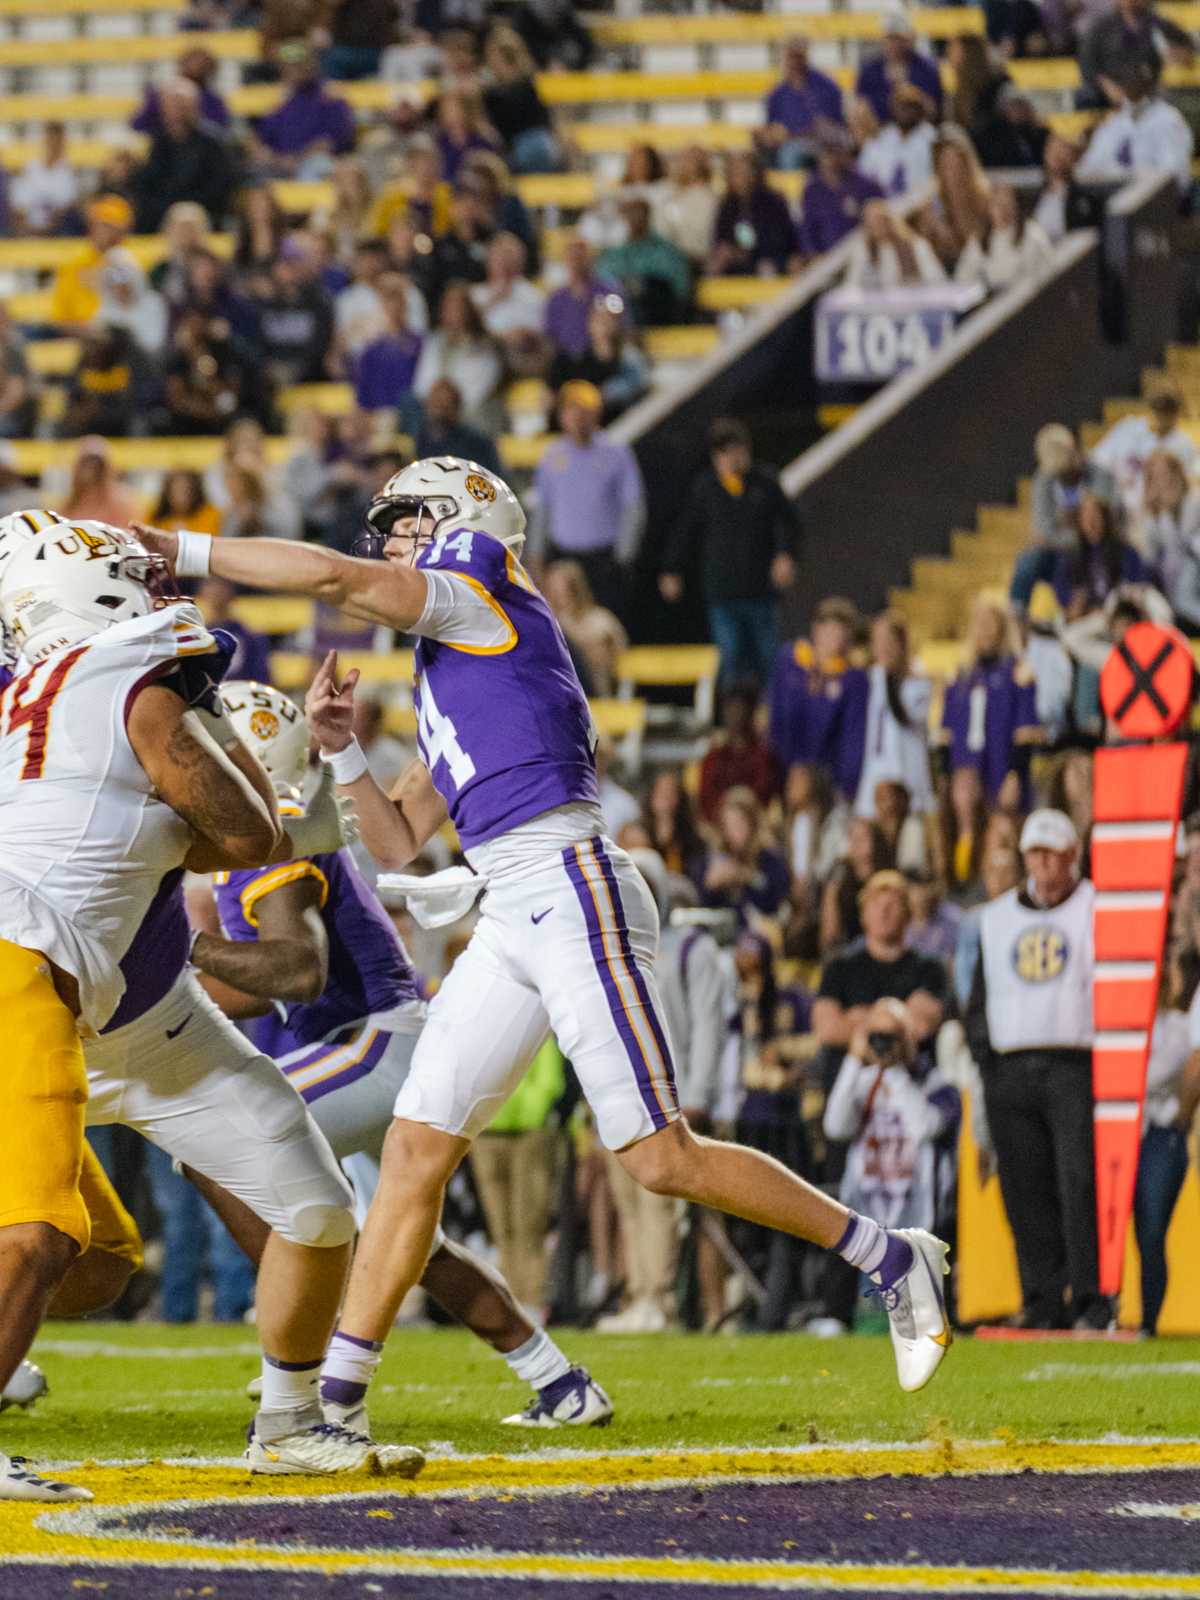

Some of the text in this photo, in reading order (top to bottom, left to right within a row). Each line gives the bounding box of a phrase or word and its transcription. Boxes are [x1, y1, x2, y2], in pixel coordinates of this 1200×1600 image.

[836, 313, 930, 375] 104
[426, 531, 475, 565] 14
[222, 691, 298, 724] LSU
[414, 667, 477, 792] 4
